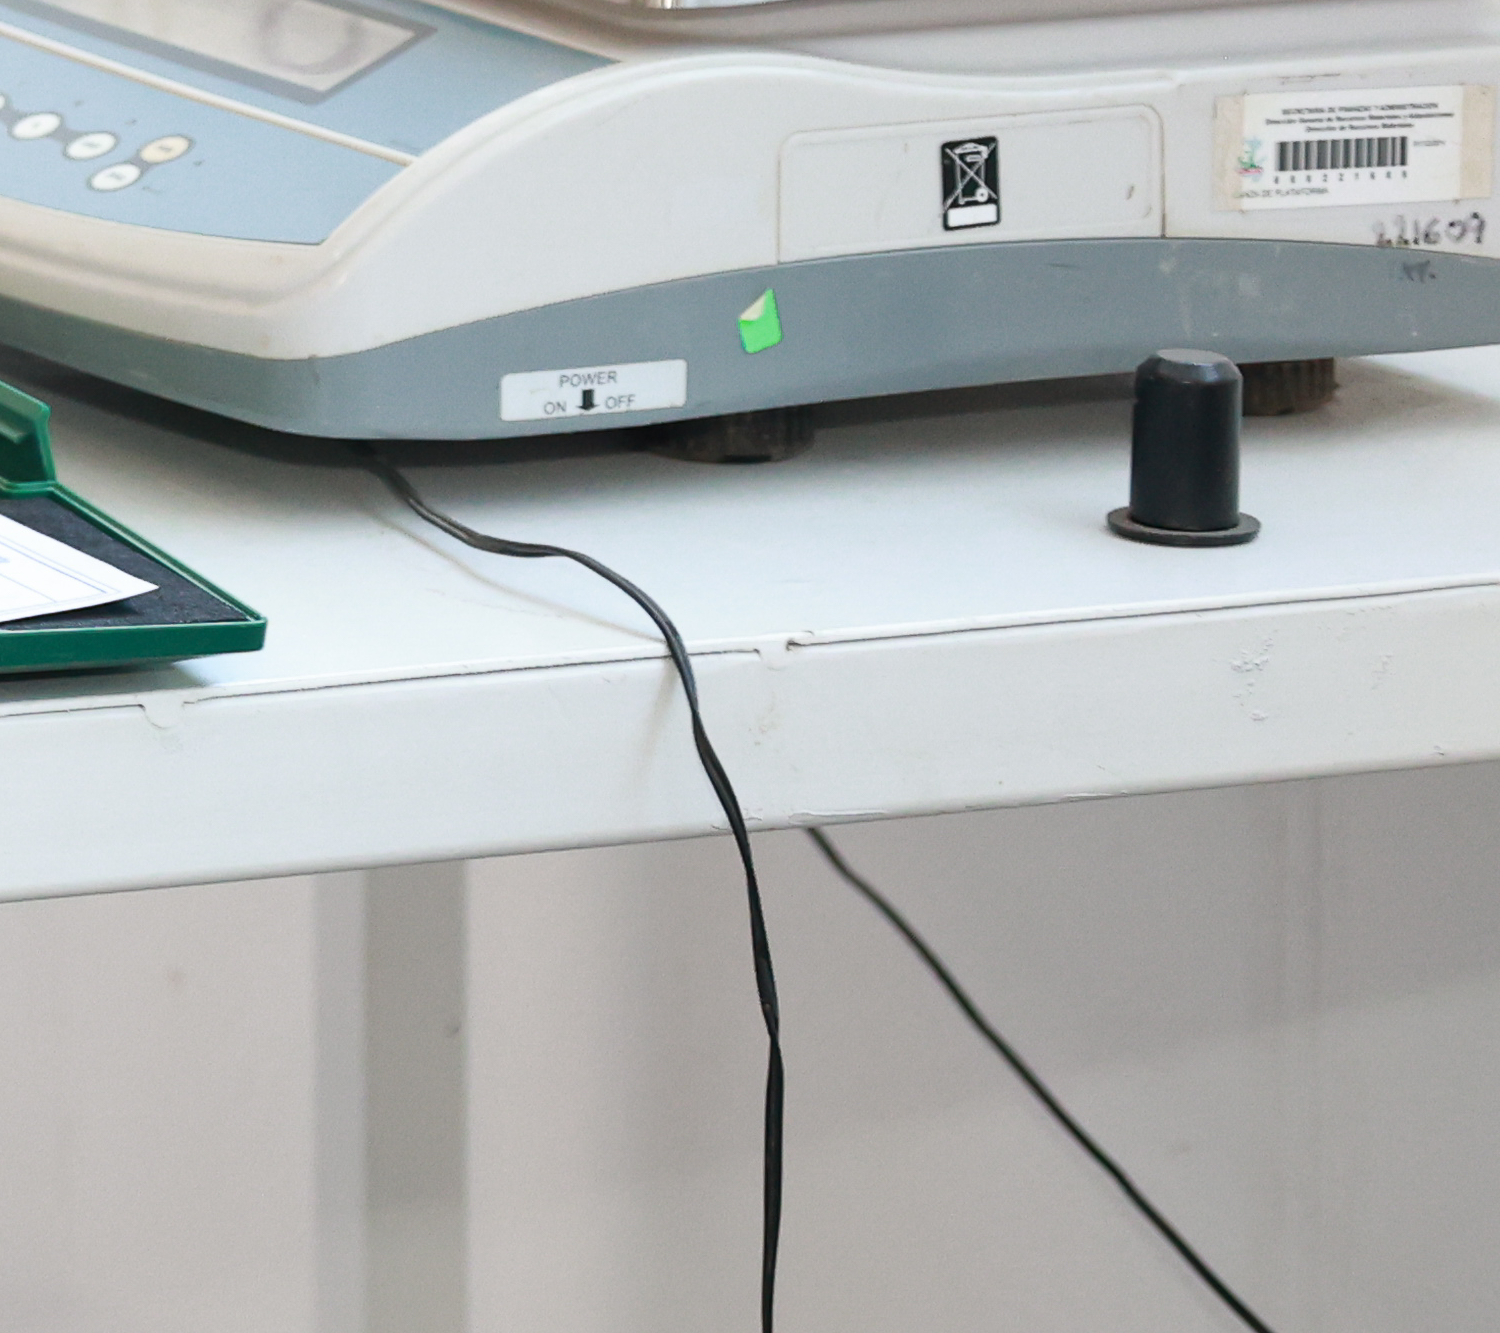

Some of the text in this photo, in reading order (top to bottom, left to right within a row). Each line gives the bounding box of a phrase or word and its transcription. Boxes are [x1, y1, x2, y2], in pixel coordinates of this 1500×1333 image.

[559, 371, 617, 388] POWER
[544, 395, 635, 415] ON OFF
